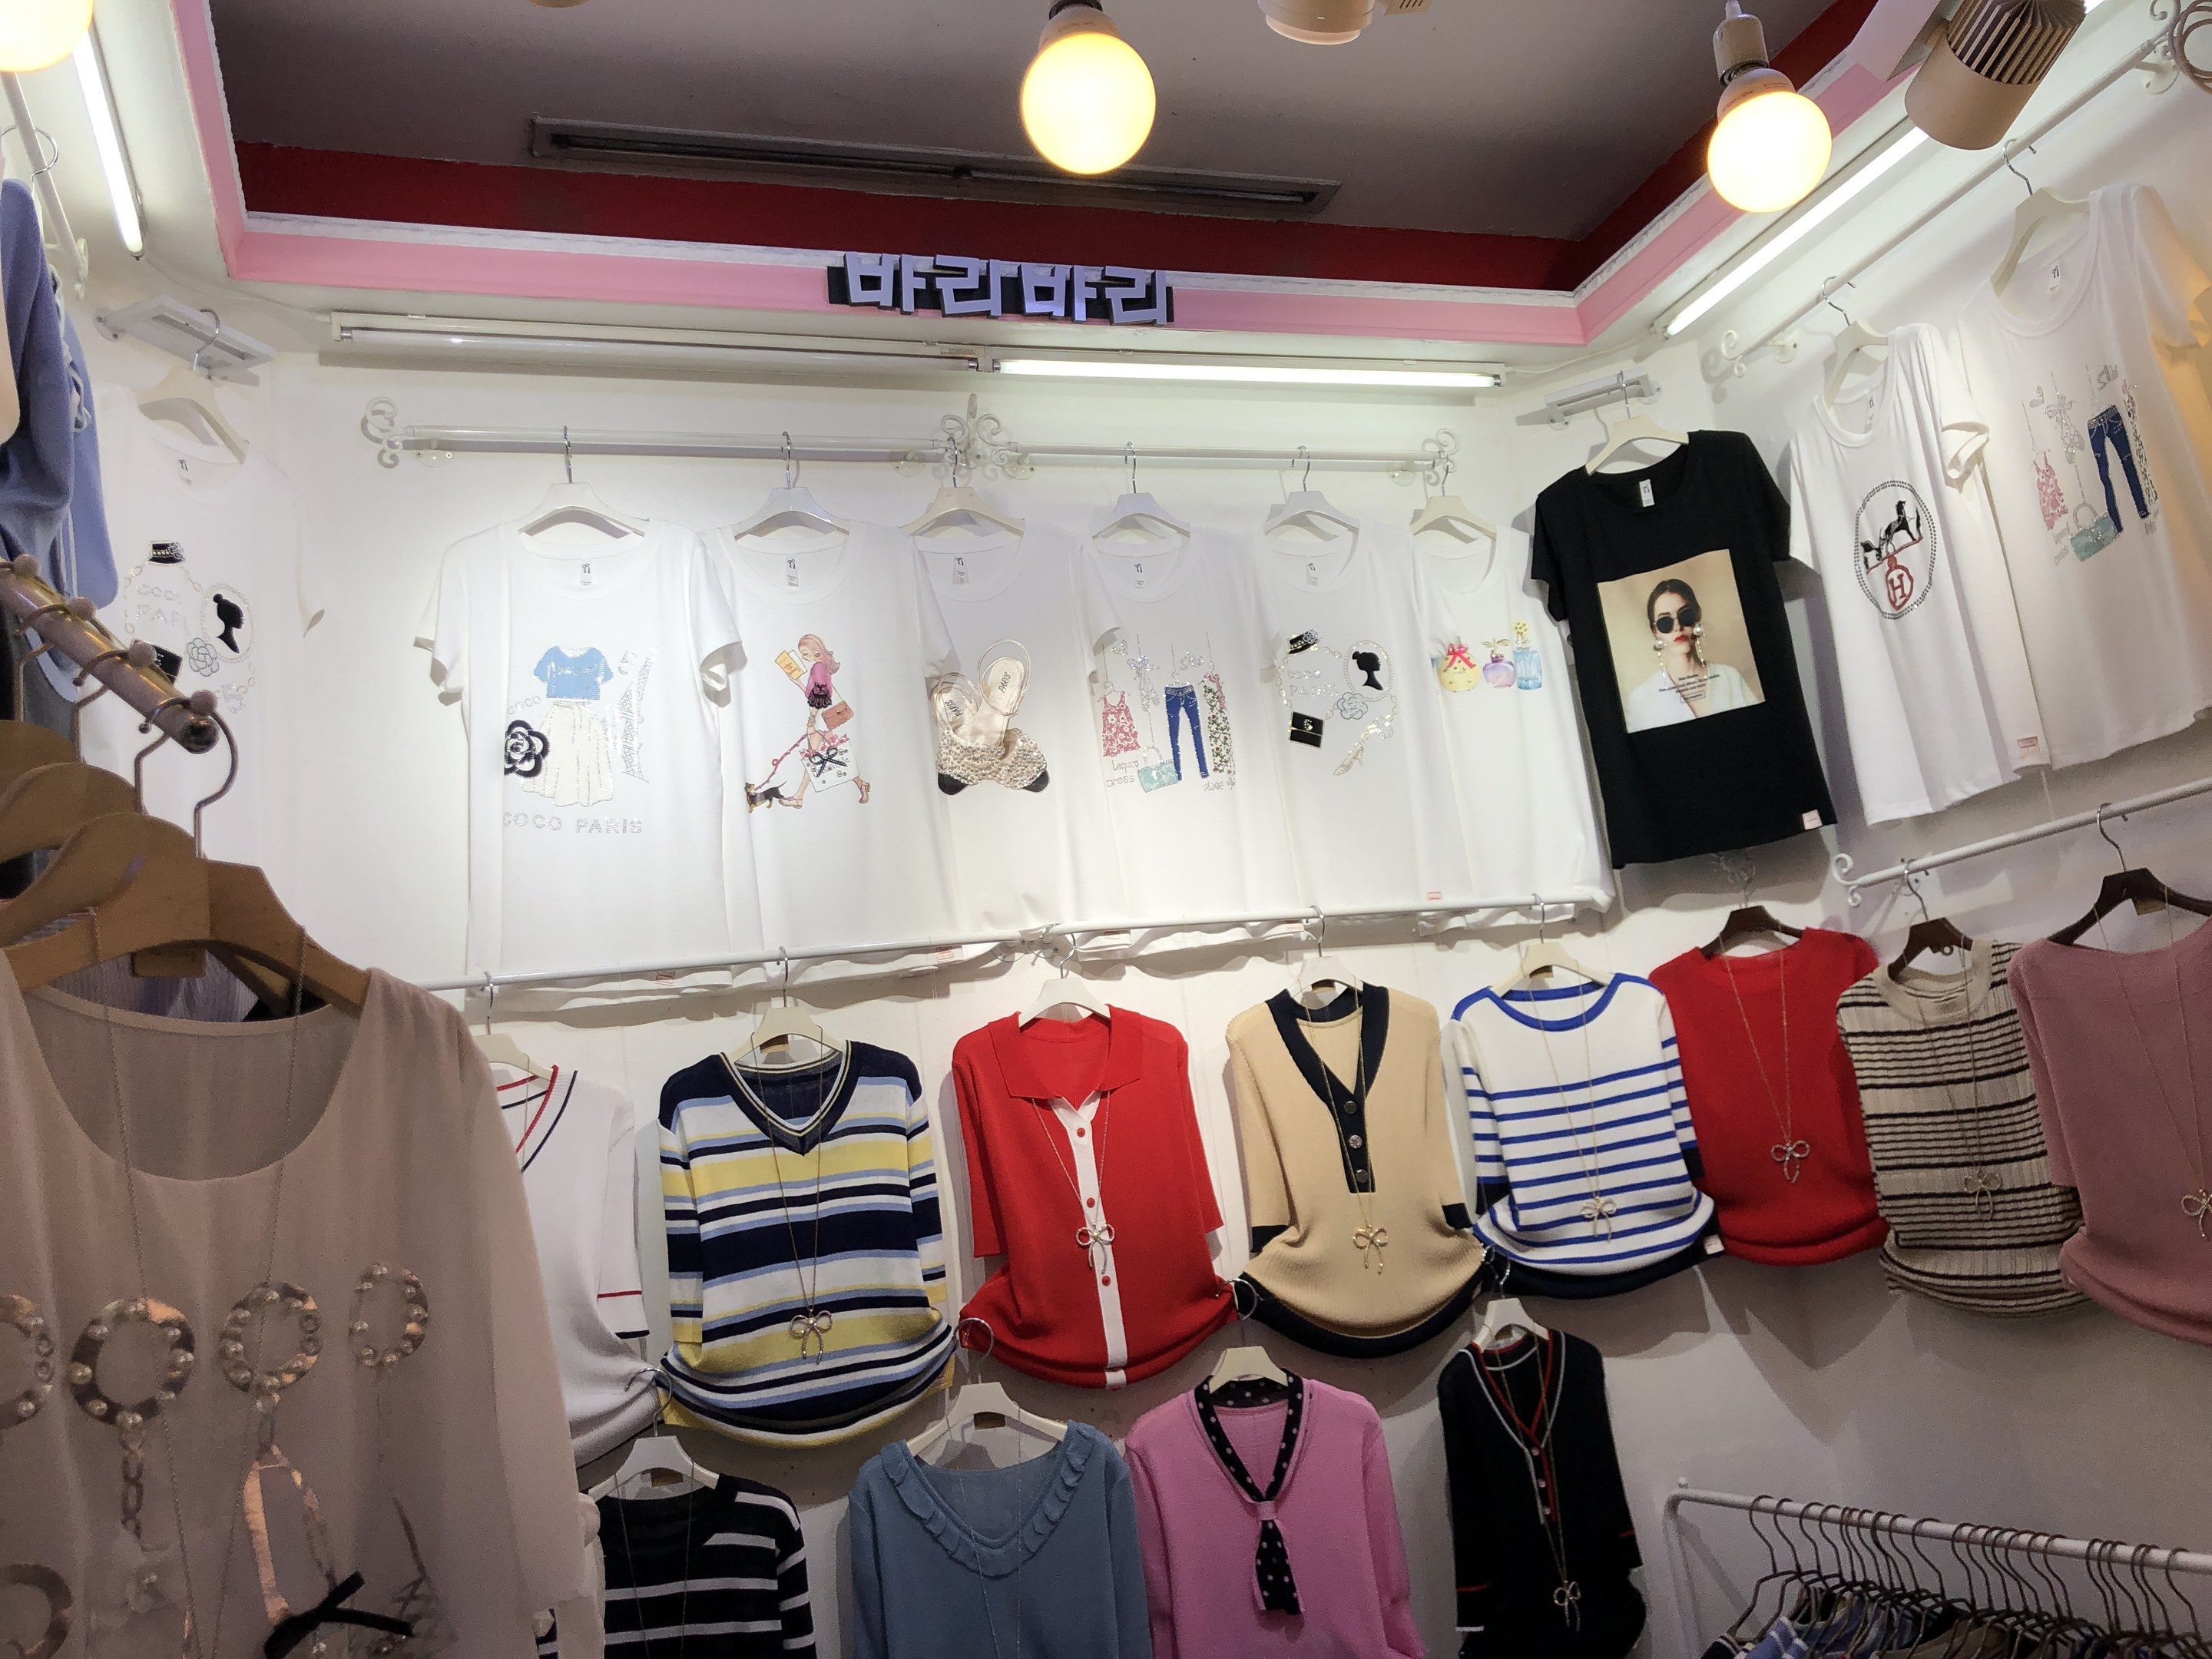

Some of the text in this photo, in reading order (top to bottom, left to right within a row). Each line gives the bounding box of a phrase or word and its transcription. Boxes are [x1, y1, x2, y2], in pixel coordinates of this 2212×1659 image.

[843, 252, 1167, 326] 바리바리
[998, 671, 1012, 694] PARIS
[944, 700, 965, 717] PARIS
[576, 817, 644, 835] PARIS
